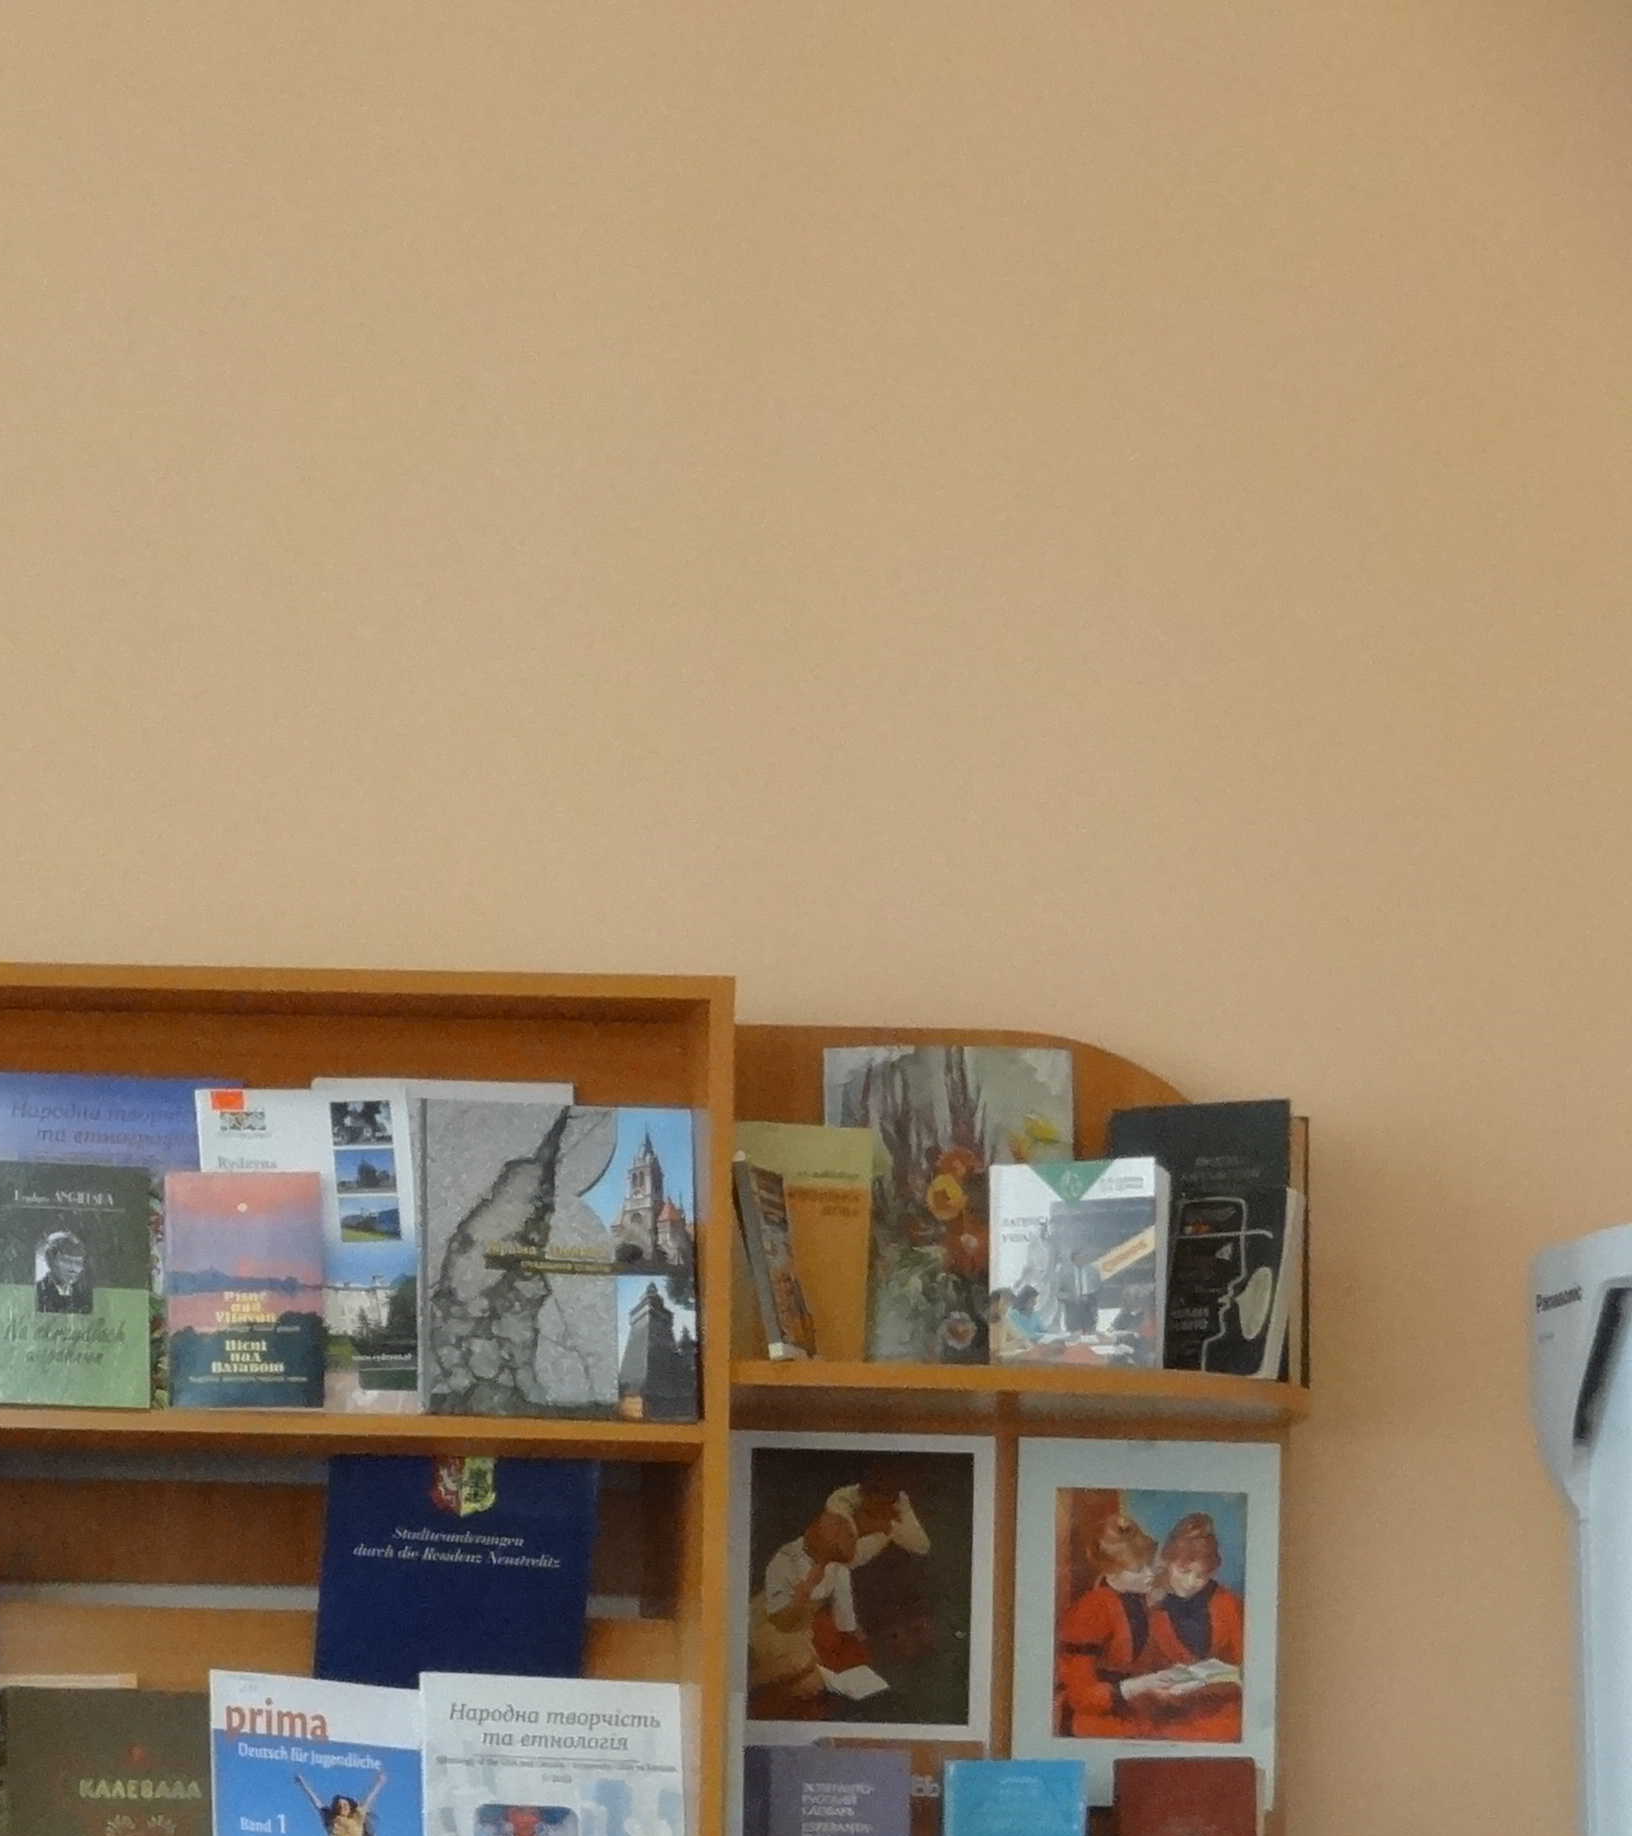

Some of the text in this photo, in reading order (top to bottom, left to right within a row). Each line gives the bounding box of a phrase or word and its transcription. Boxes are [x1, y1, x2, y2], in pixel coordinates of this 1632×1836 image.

[352, 1543, 394, 1560] durch
[397, 1545, 420, 1560] die
[224, 1696, 330, 1742] prima
[448, 1701, 662, 1731] Народна творчість
[481, 1731, 630, 1752] та етнологія
[237, 1741, 383, 1771] Deutsch für Jugendliche
[78, 1778, 203, 1799] КАЛЕВАЛА
[239, 1813, 287, 1834] Band 1
